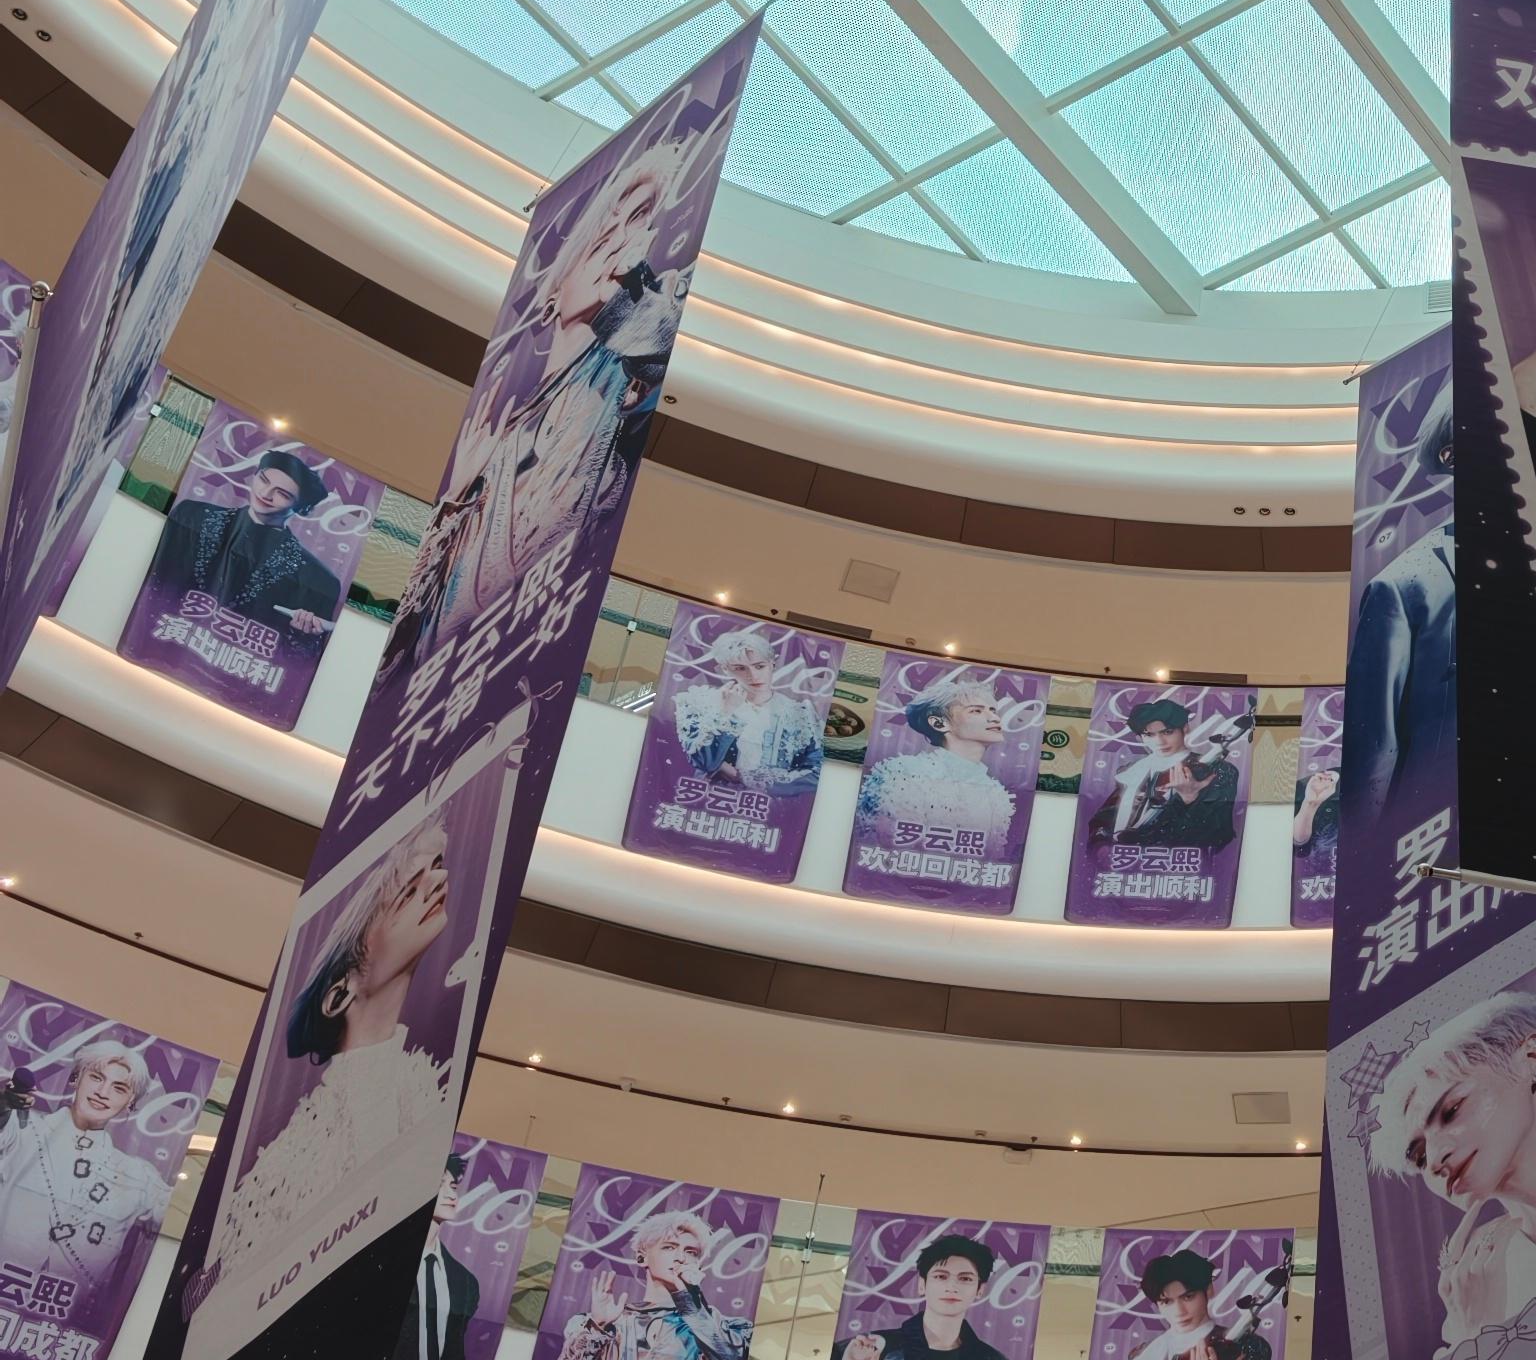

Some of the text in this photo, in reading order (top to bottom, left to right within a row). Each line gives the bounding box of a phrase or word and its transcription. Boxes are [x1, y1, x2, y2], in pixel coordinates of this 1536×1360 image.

[1378, 531, 1393, 544] 07
[181, 590, 279, 657] 罗云熙
[391, 528, 578, 738] 罗云熙
[153, 615, 284, 692] 演出顺利
[338, 570, 592, 832] 天下第一好
[675, 777, 770, 820] 罗云熙
[655, 803, 780, 852] 演出顺利
[895, 820, 985, 856] 罗云熙
[858, 845, 1013, 888] 欢迎回成都
[1111, 845, 1200, 872] 罗云熙
[1094, 872, 1213, 901] 演出顺利
[257, 1196, 379, 1311] LUO YUNXI
[0, 1265, 78, 1319] 云熙
